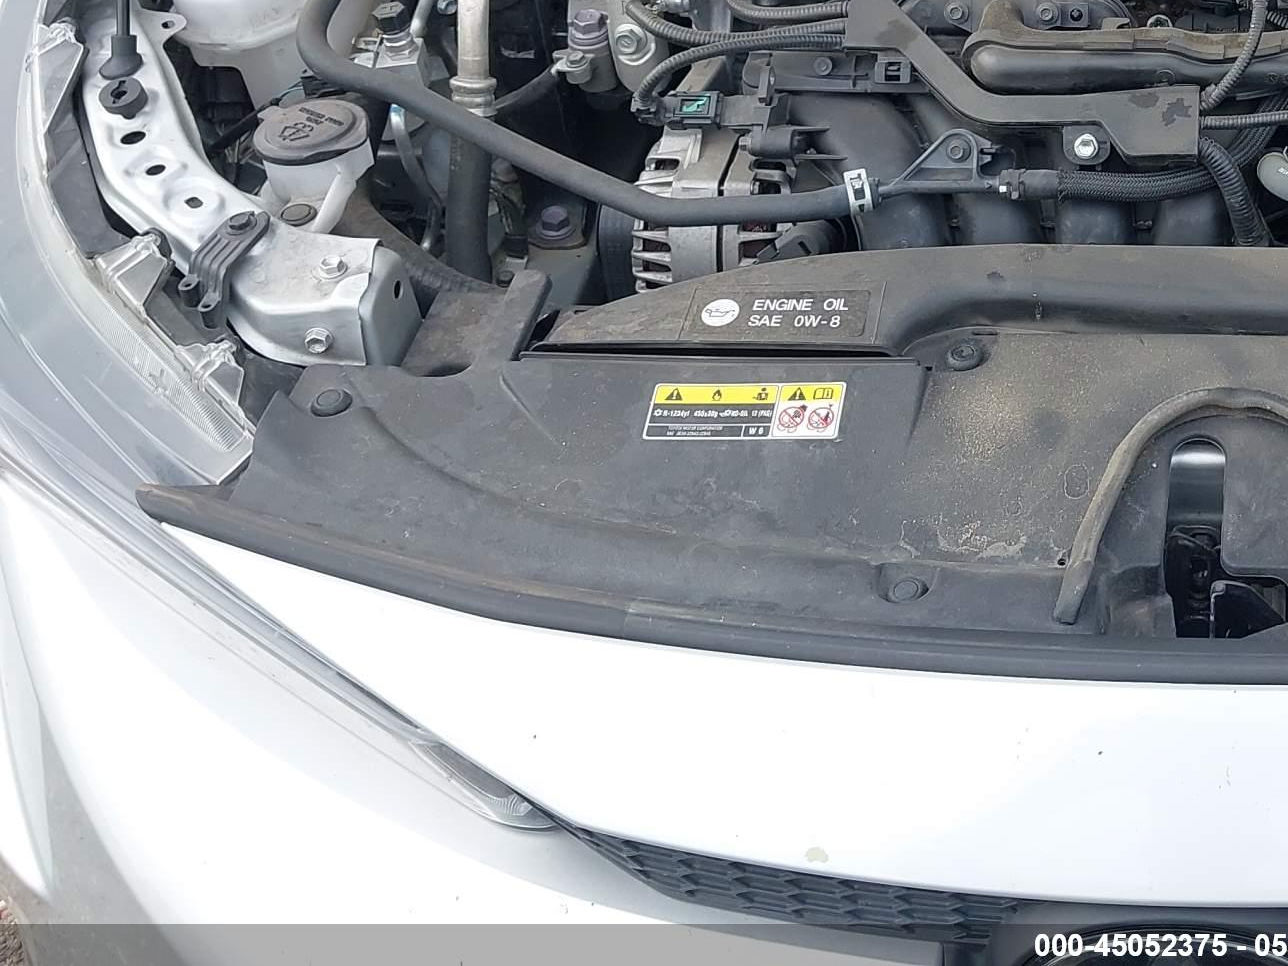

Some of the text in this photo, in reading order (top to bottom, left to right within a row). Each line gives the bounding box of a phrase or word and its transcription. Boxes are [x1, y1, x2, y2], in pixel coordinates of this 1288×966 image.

[752, 298, 849, 311] ENGINE OIL
[747, 314, 841, 327] SAE 0W-8
